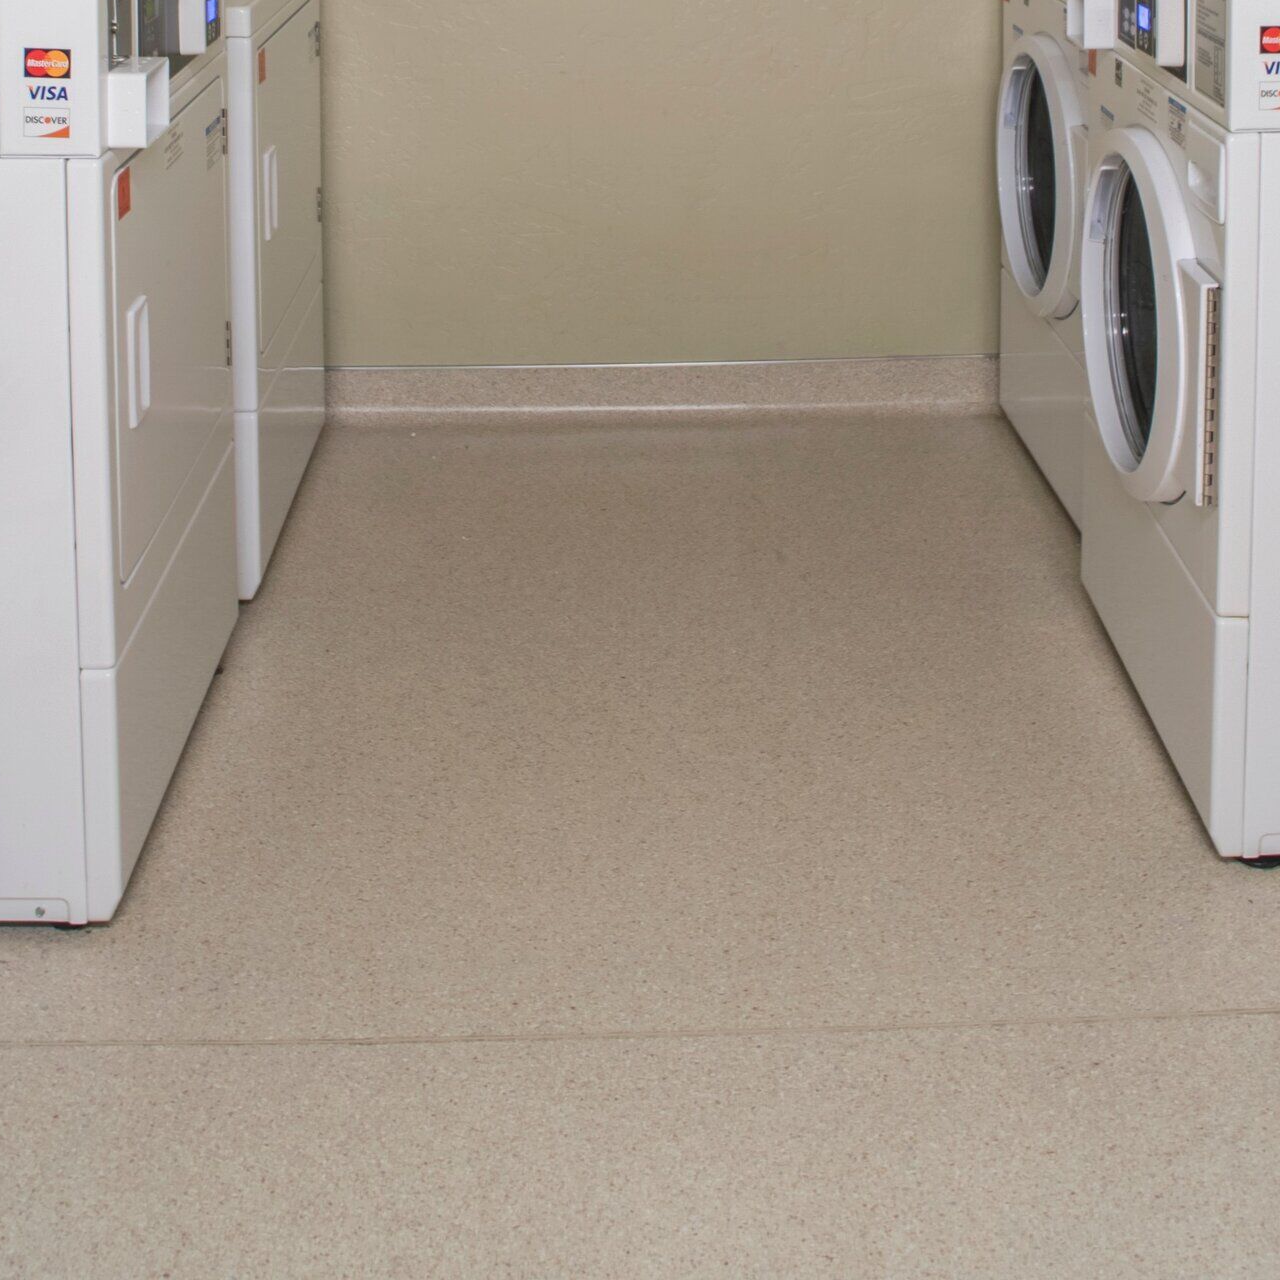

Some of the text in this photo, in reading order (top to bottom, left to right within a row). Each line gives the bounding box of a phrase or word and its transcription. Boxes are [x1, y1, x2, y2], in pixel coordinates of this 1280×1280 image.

[26, 58, 69, 69] MasterCard
[28, 85, 68, 101] VISA
[25, 115, 68, 125] DISCOVER
